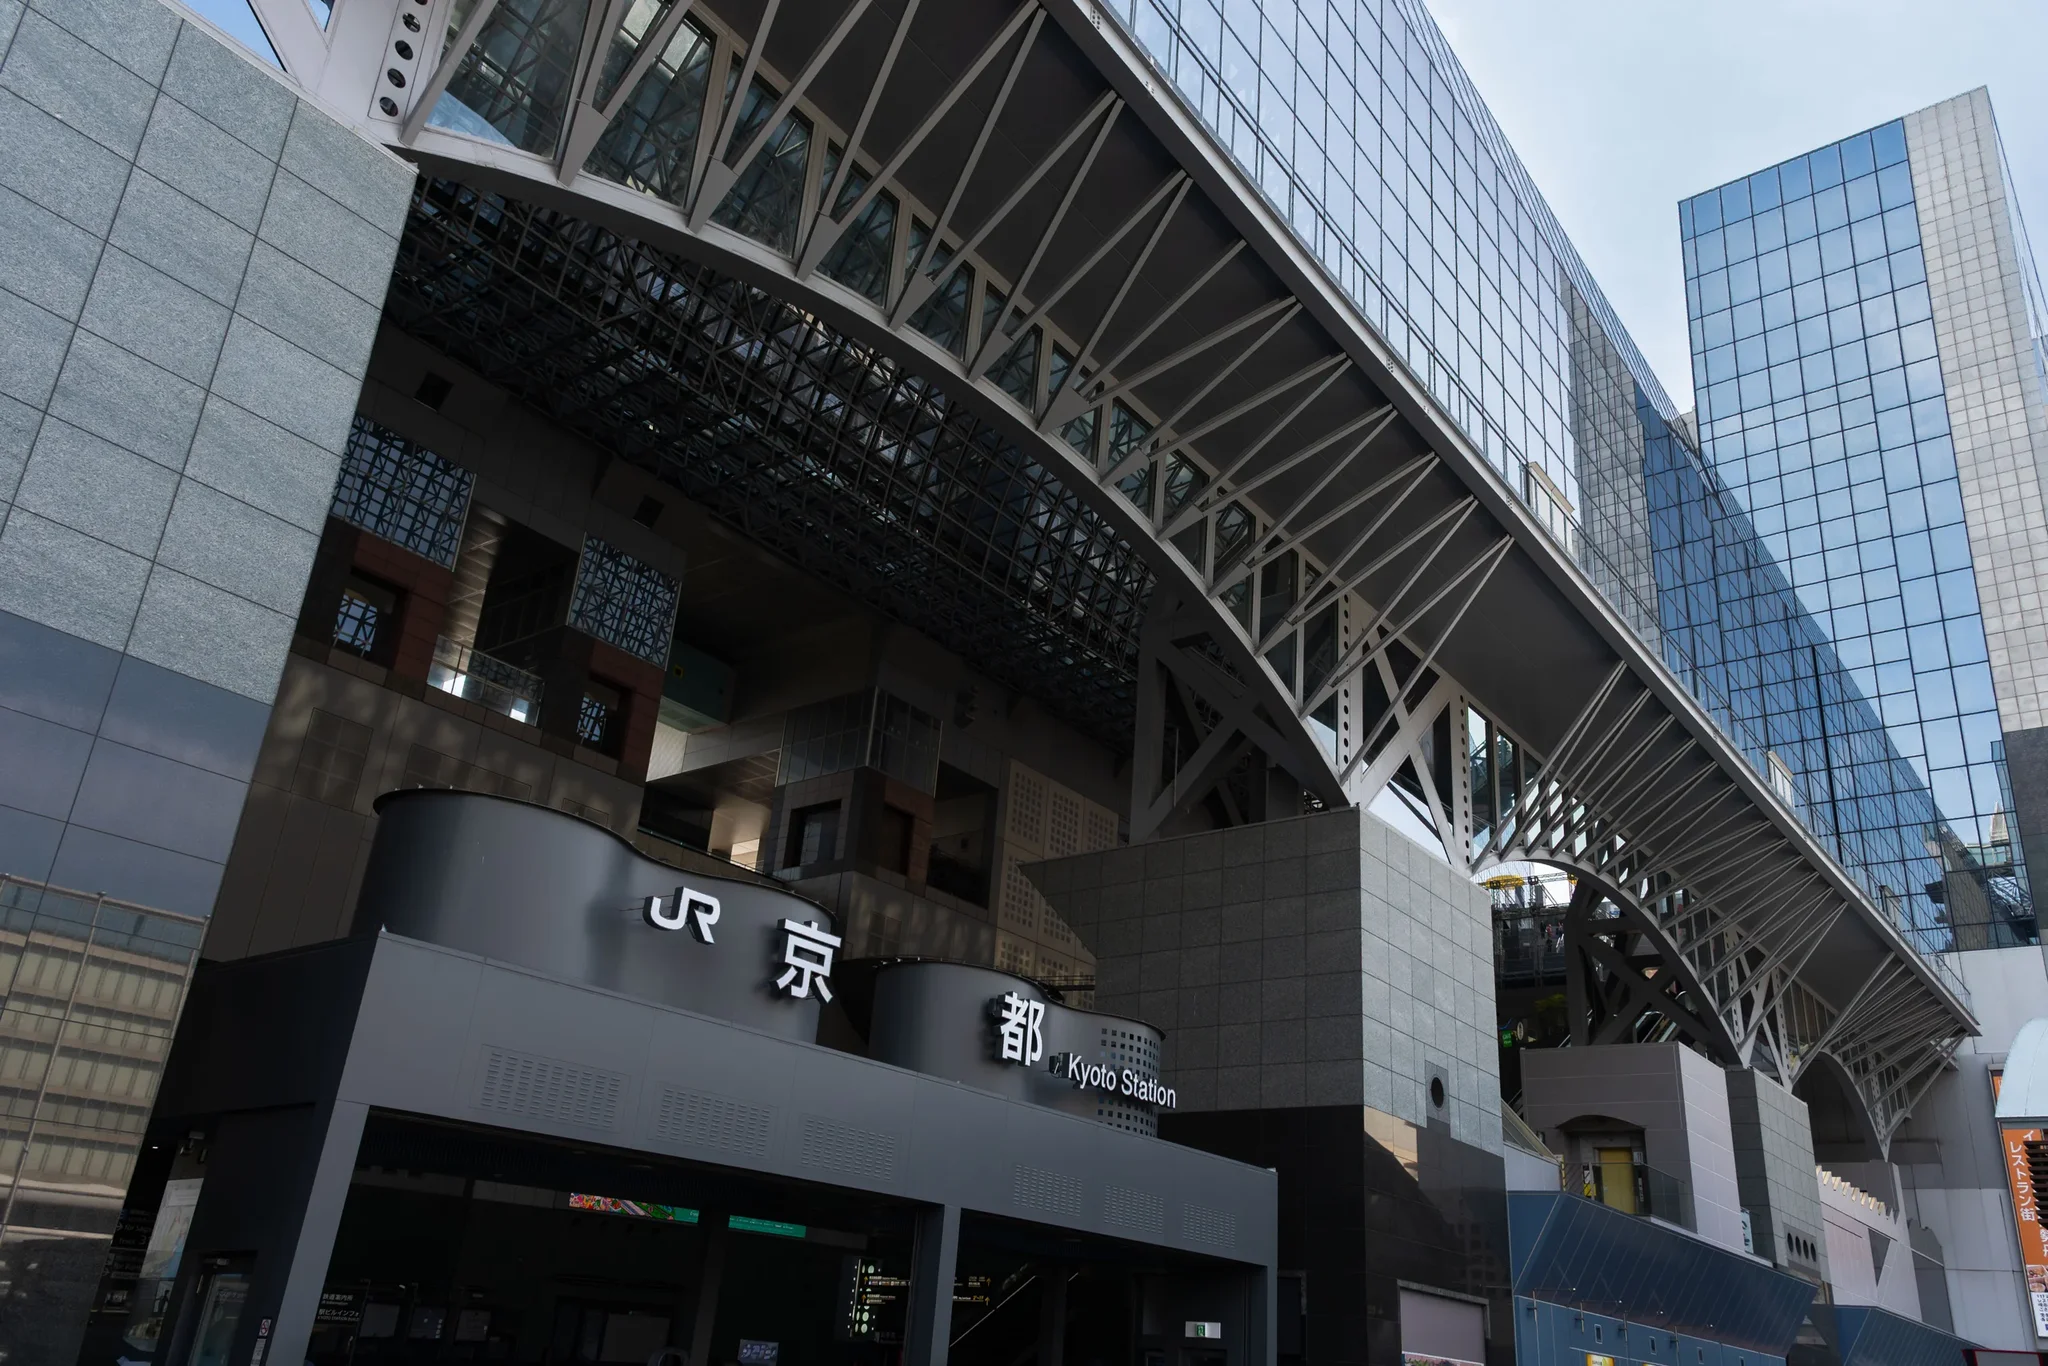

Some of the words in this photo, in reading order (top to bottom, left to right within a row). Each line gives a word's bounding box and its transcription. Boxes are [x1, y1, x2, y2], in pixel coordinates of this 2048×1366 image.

[649, 886, 722, 945] JR
[1067, 1052, 1118, 1091] Kyoto
[1121, 1069, 1177, 1110] Station
[2009, 1140, 2036, 1222] レストラン街
